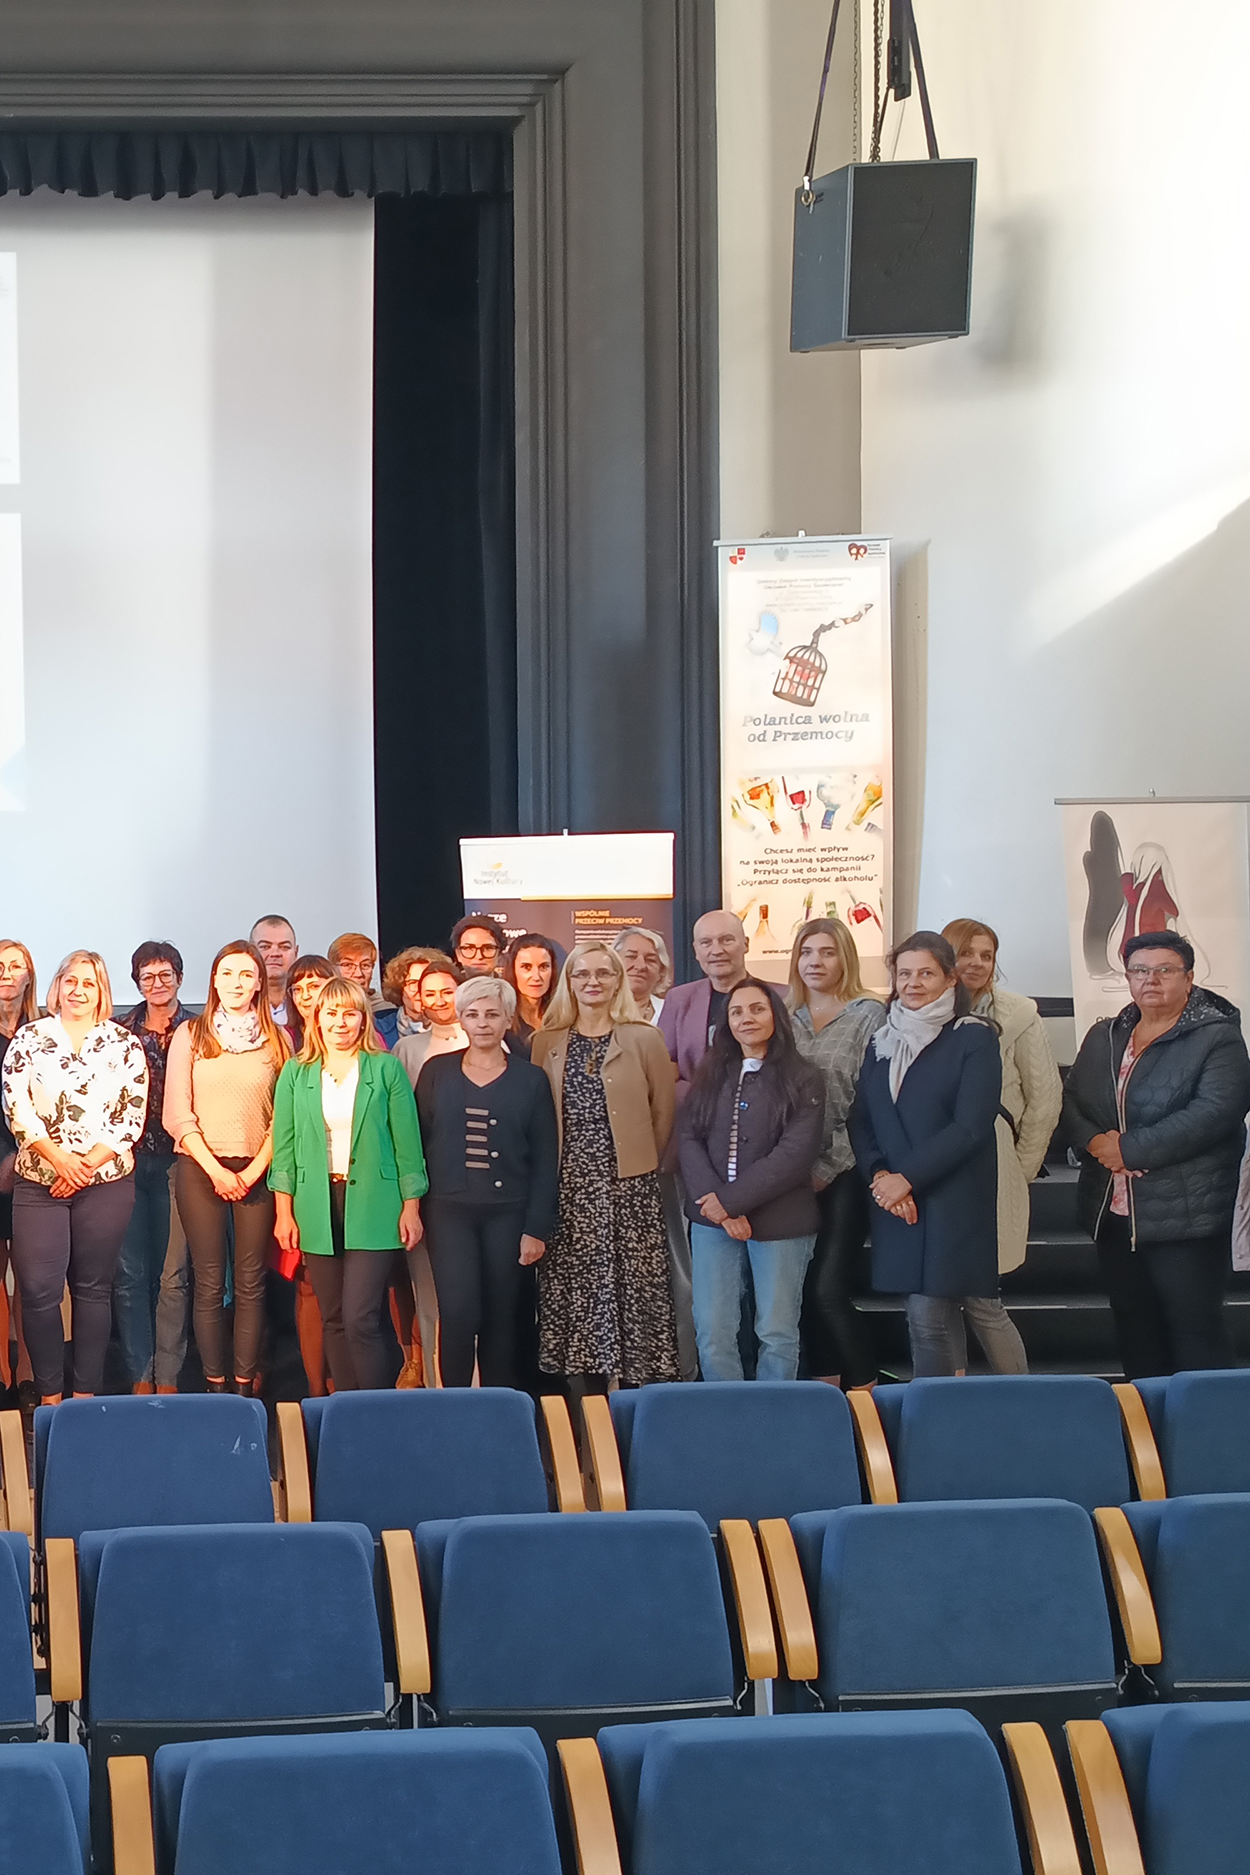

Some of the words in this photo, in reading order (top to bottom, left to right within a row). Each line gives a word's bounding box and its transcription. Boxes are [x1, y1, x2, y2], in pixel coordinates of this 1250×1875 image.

[742, 712, 813, 727] Polanica
[818, 710, 870, 724] wolna
[747, 730, 768, 743] od
[771, 729, 855, 742] Przemocy
[764, 846, 794, 855] Chcesz
[796, 846, 817, 854] mieć
[820, 845, 849, 854] wpływ
[753, 858, 779, 866] swoją
[781, 856, 813, 864] lokalną
[816, 854, 876, 864] społeczność?
[753, 867, 789, 876] Przyłącz
[792, 866, 804, 875] się
[806, 865, 818, 873] do
[820, 865, 862, 874] kampanii
[782, 875, 831, 885] dostępność
